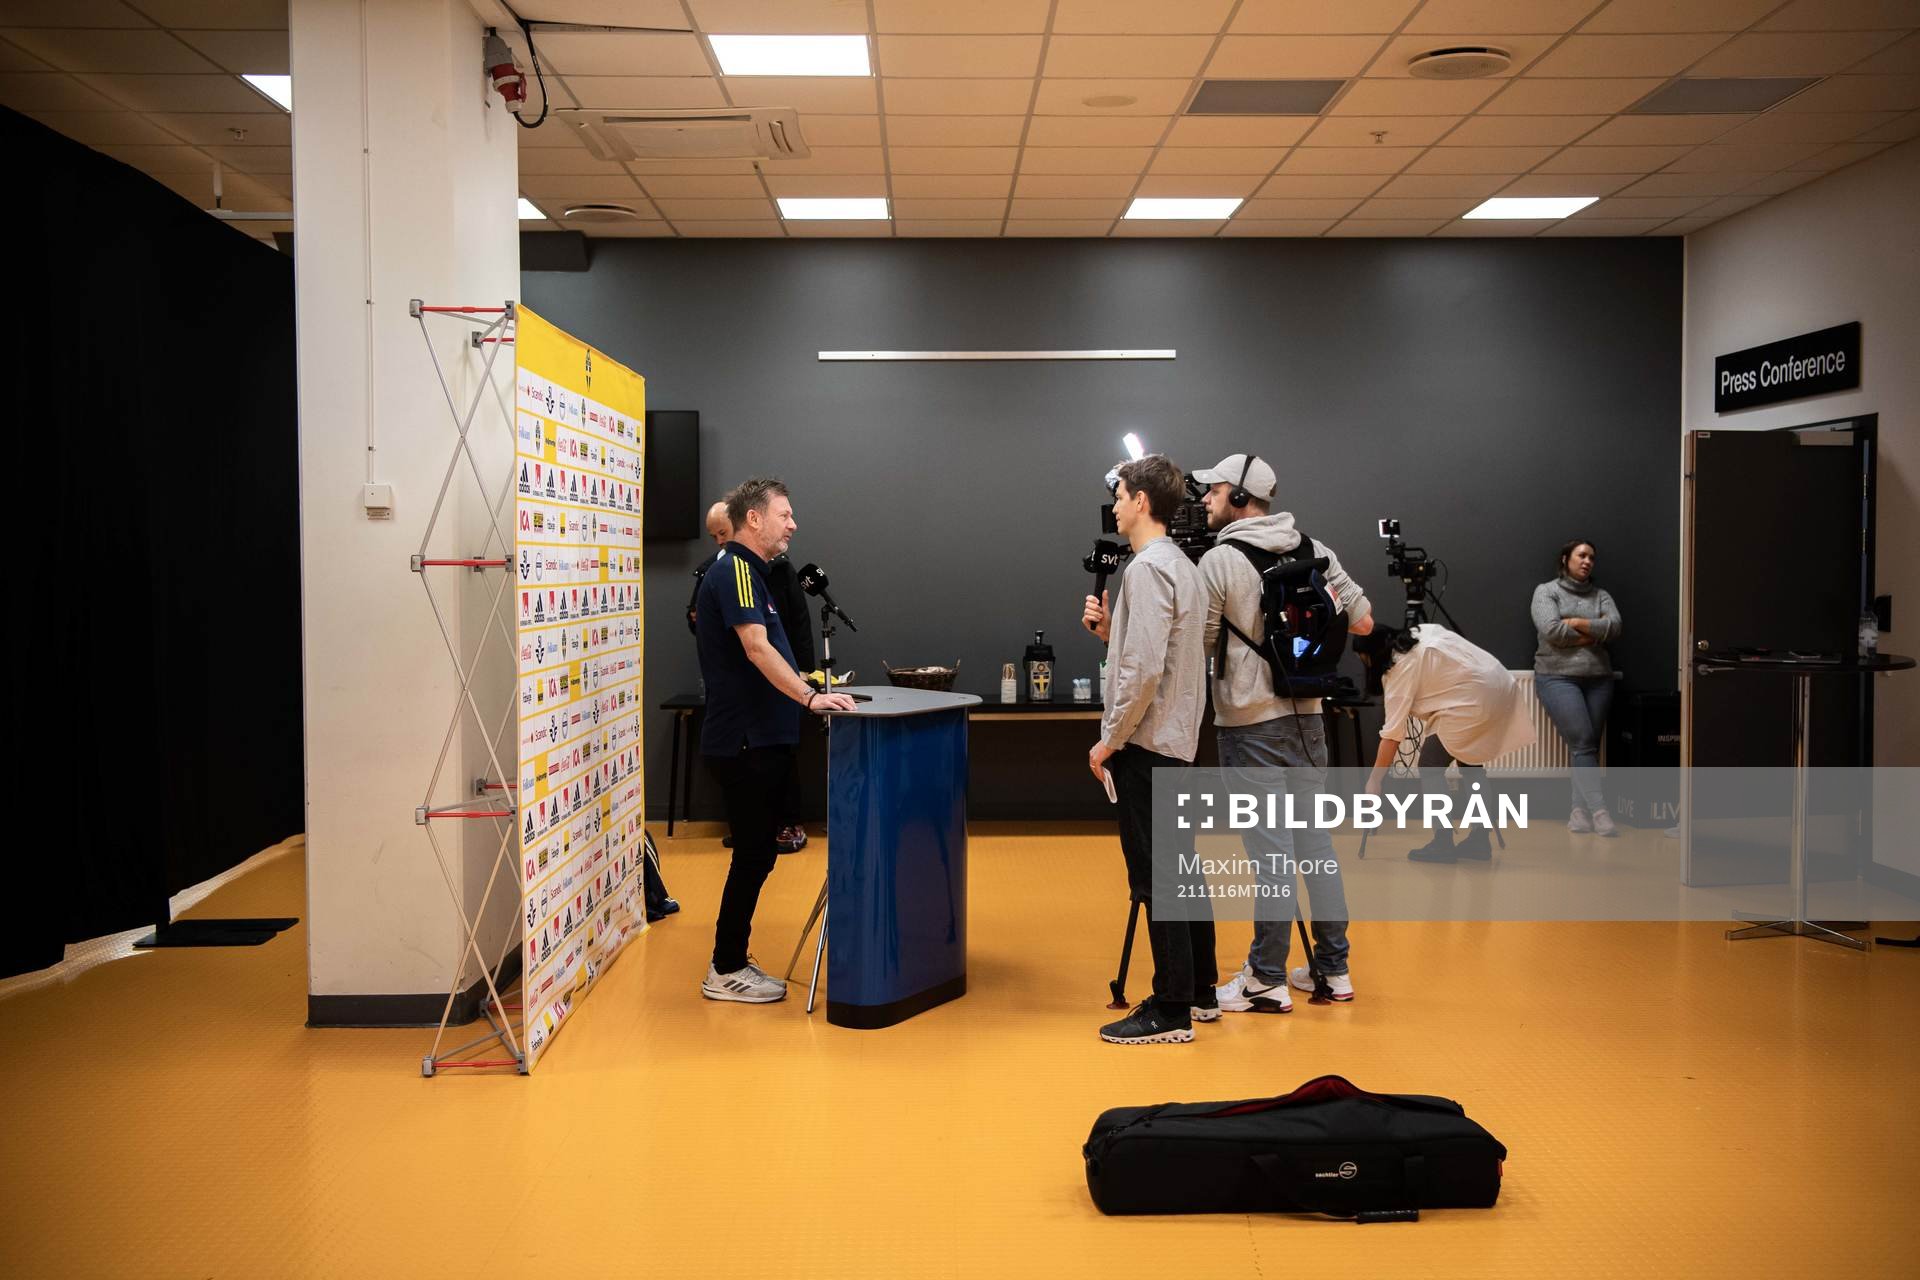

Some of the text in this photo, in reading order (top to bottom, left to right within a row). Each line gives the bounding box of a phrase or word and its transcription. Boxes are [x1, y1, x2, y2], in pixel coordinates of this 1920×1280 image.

[1721, 350, 1846, 396] Press Conference
[1101, 554, 1118, 566] svt
